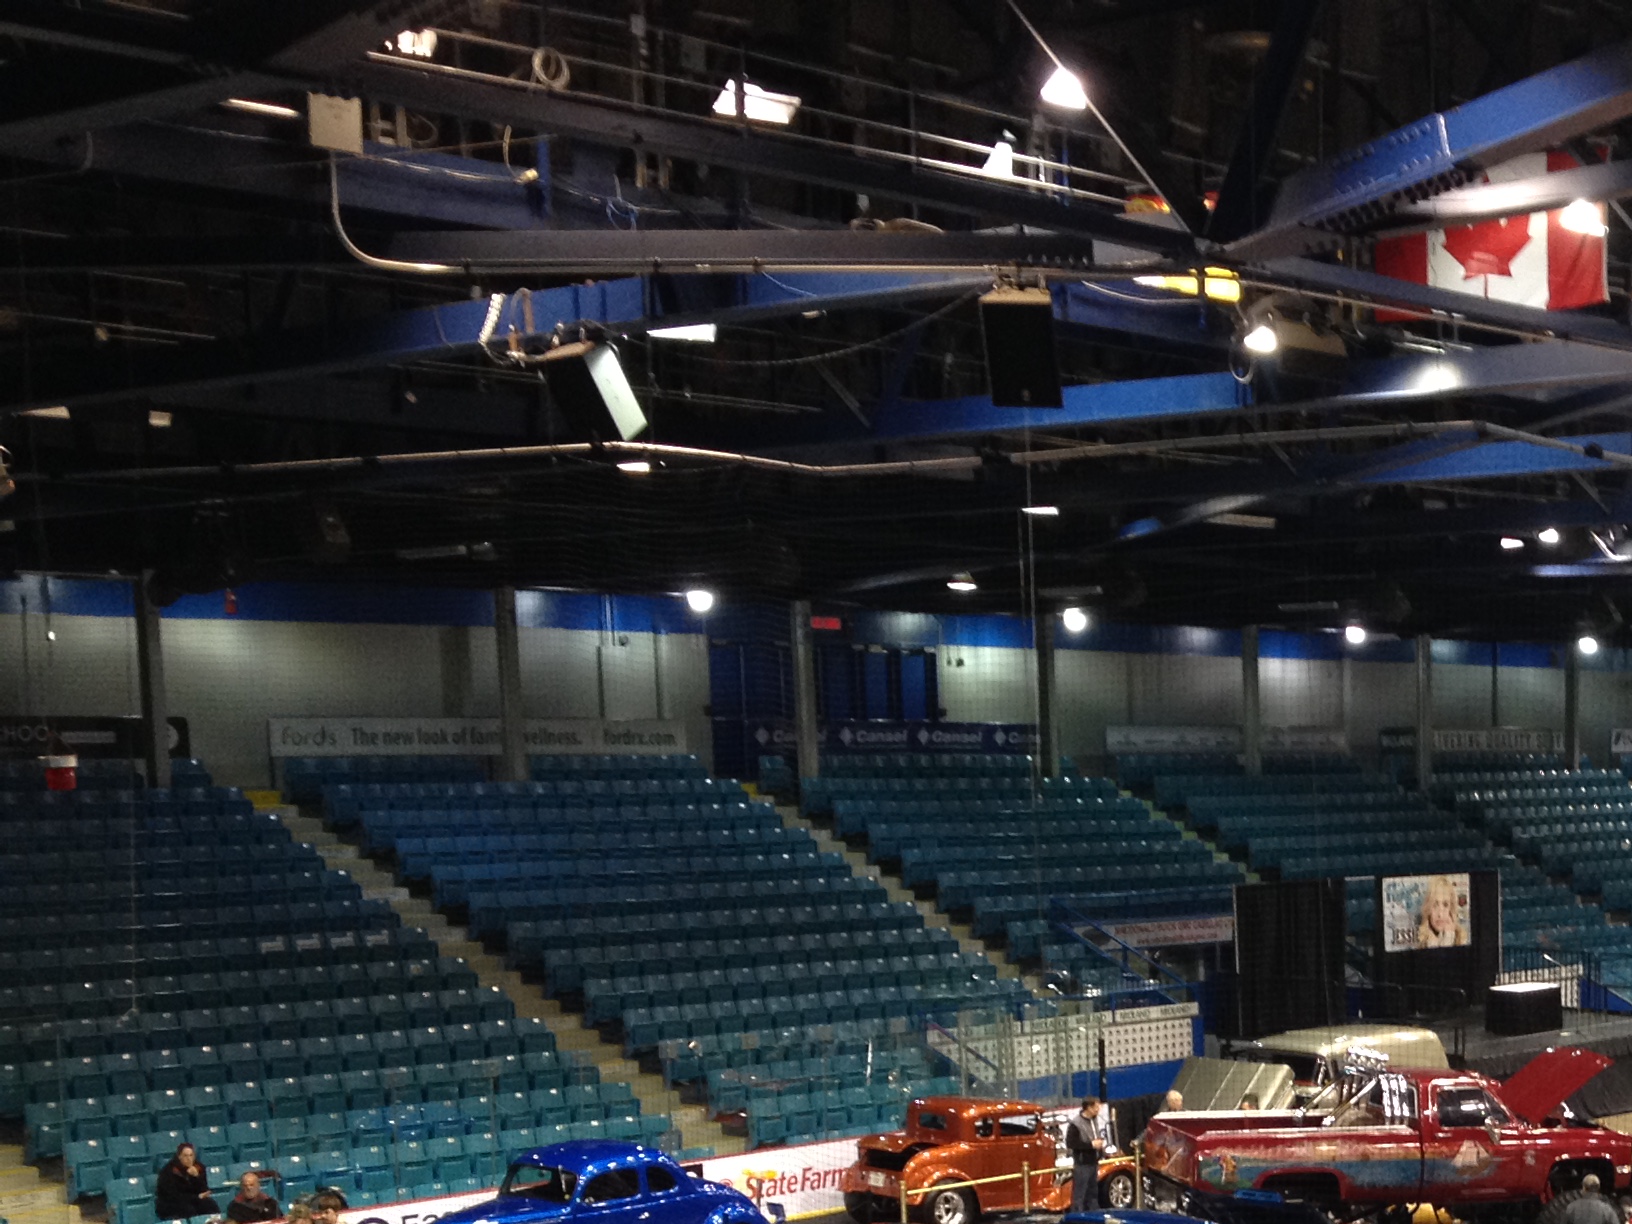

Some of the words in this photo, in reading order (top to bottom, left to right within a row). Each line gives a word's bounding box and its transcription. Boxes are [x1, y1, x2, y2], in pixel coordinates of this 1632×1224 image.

[353, 726, 378, 745] The
[382, 731, 414, 745] new
[416, 725, 449, 744] look
[856, 729, 908, 743] Cansel
[932, 729, 983, 743] Cansel
